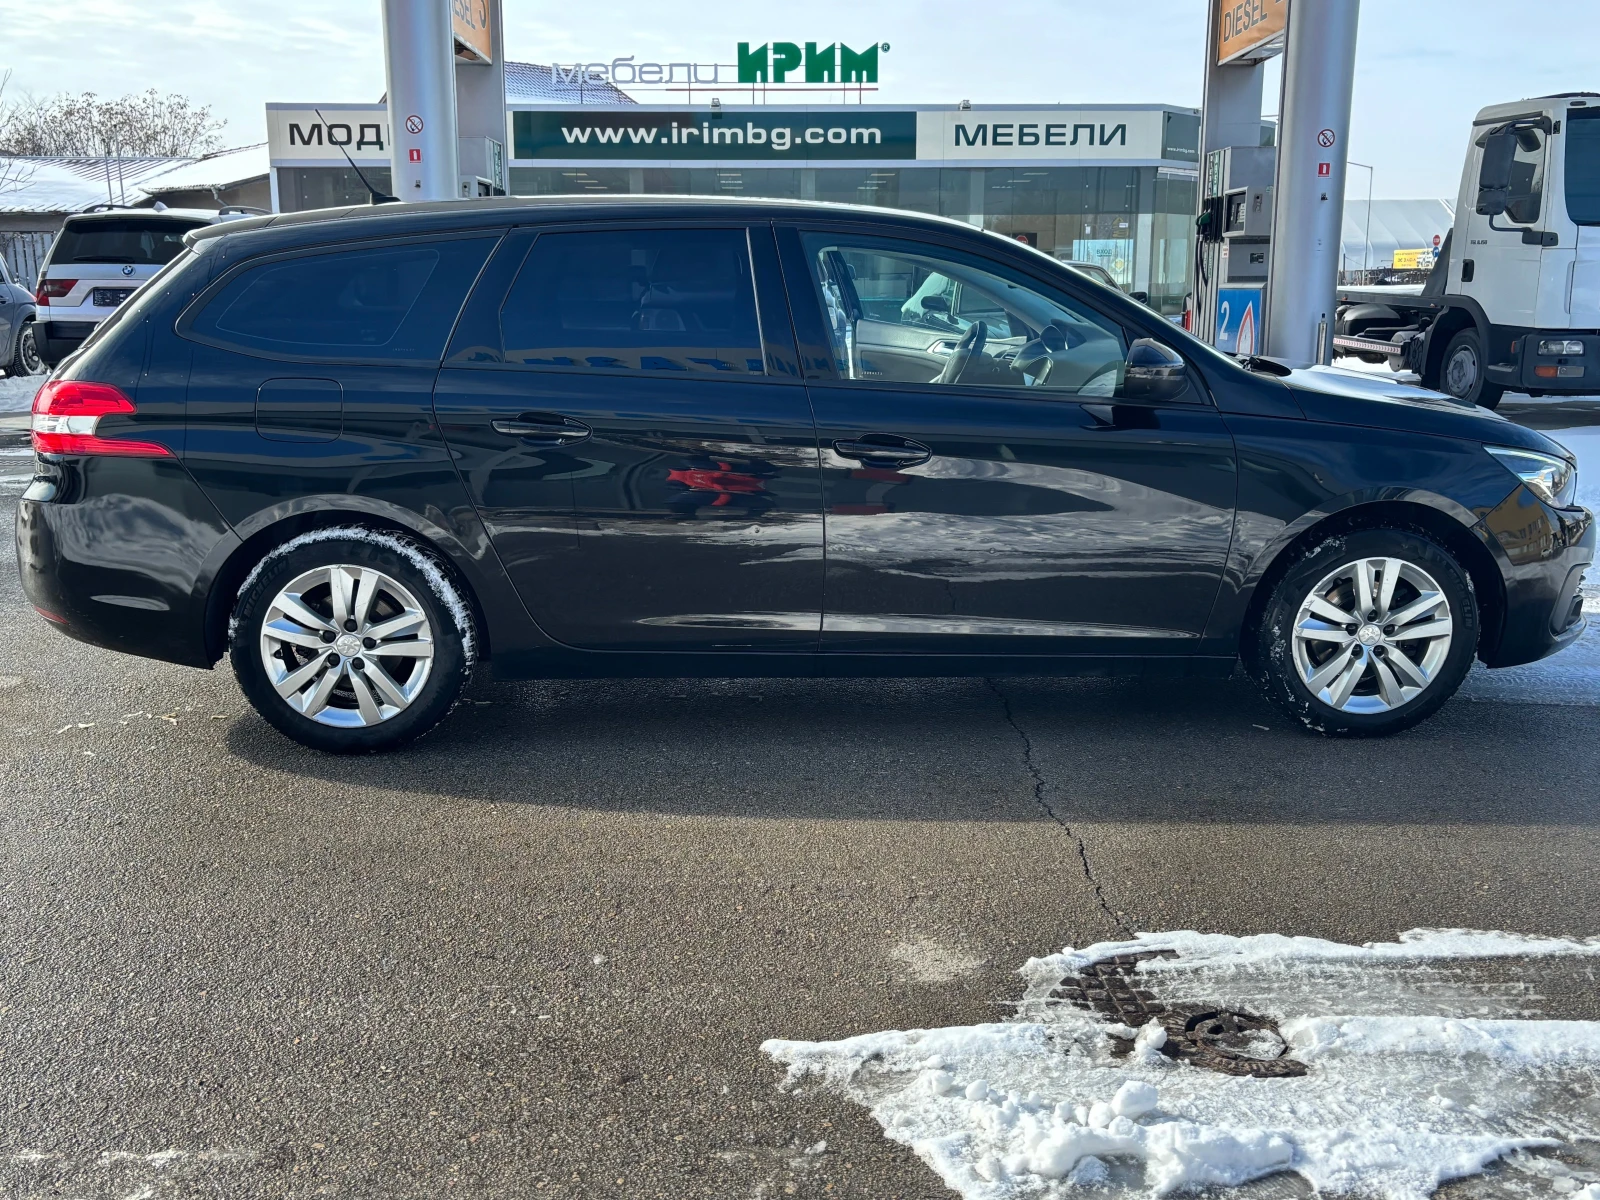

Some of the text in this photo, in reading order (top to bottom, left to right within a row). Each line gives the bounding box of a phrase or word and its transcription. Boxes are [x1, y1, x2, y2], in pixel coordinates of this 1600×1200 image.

[1223, 0, 1268, 43] DIESEL
[551, 55, 719, 85] мебели
[289, 123, 391, 151] МОД
[561, 121, 882, 150] www.irimbg.com
[954, 123, 1127, 147] МЕБЕЛИ
[1219, 300, 1230, 340] 2
